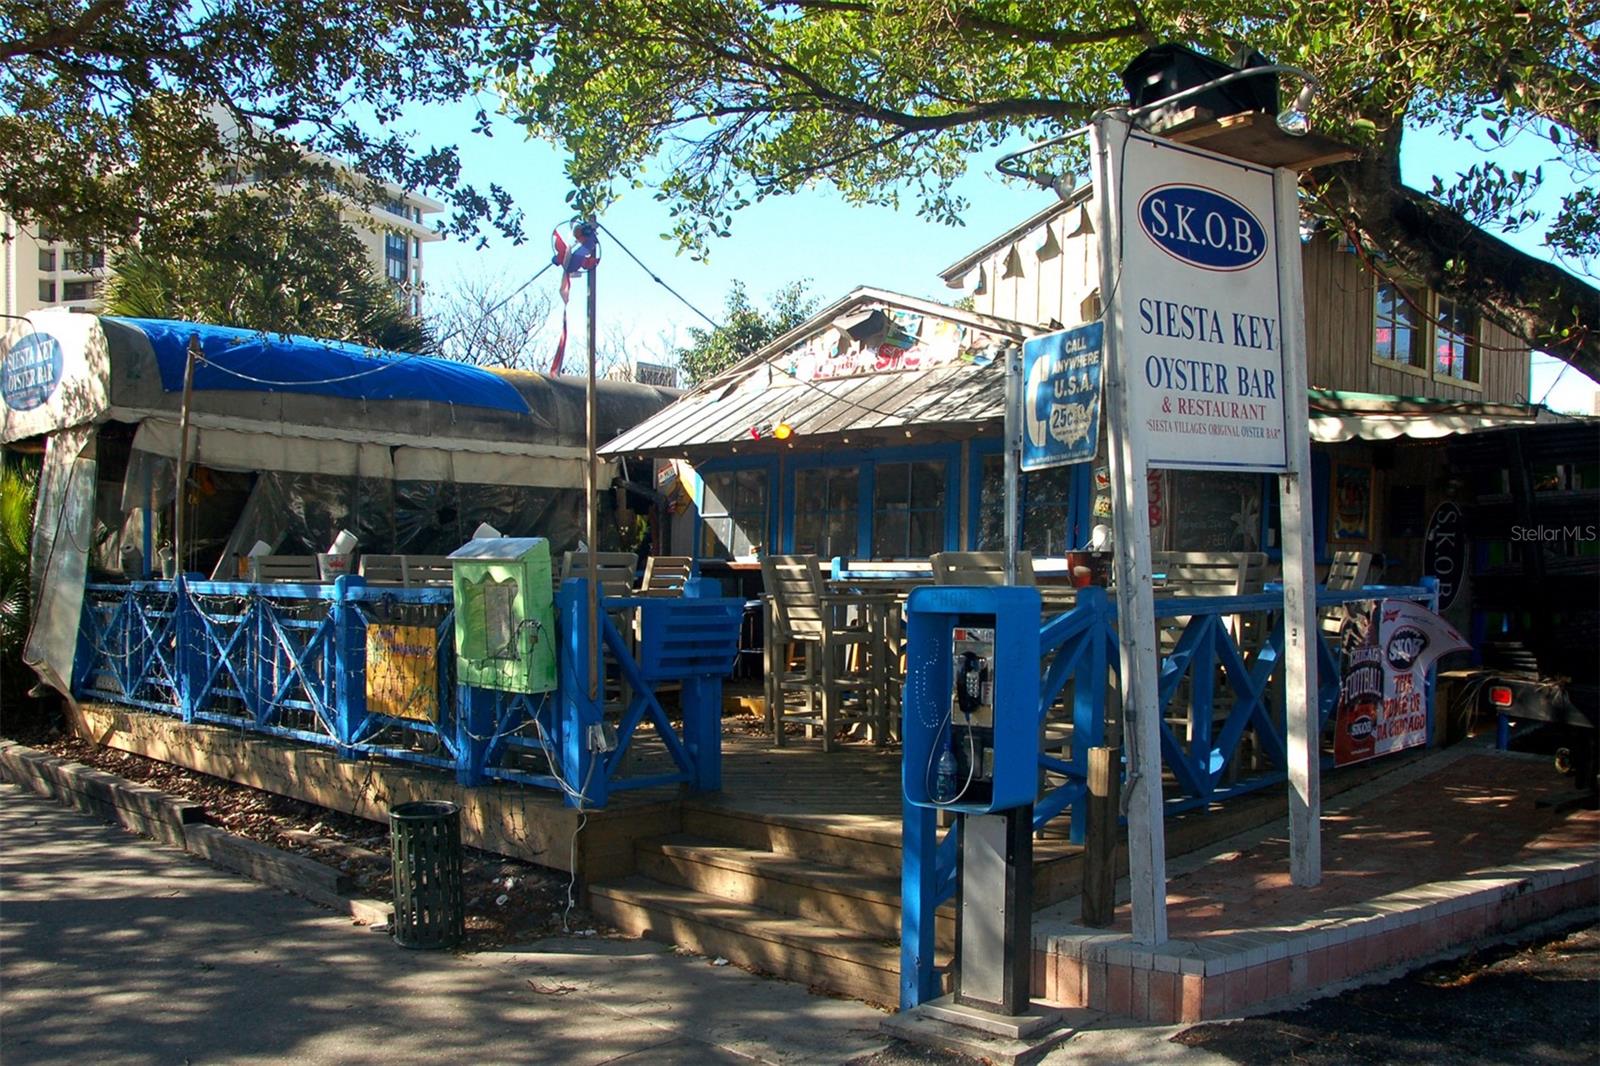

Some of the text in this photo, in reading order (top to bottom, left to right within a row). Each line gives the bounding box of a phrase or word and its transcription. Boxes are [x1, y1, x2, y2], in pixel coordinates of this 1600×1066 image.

[1150, 198, 1258, 256] S.K.O.B.
[1139, 297, 1276, 351] SIESTA KEY
[7, 338, 55, 372] SIESTA KEY
[1065, 336, 1087, 354] CALL
[1052, 350, 1100, 375] ANYWHERE
[8, 363, 54, 392] OYSTER BAR
[1054, 373, 1093, 399] U.S.A.
[1145, 355, 1277, 400] OYSTER BAR
[1161, 396, 1267, 421] & RESTAURANT
[1174, 420, 1207, 436] VILLAGES
[1208, 423, 1240, 438] ORIGINAL
[1241, 425, 1265, 439] OYSTER
[1342, 667, 1382, 703] FOOTBALL
